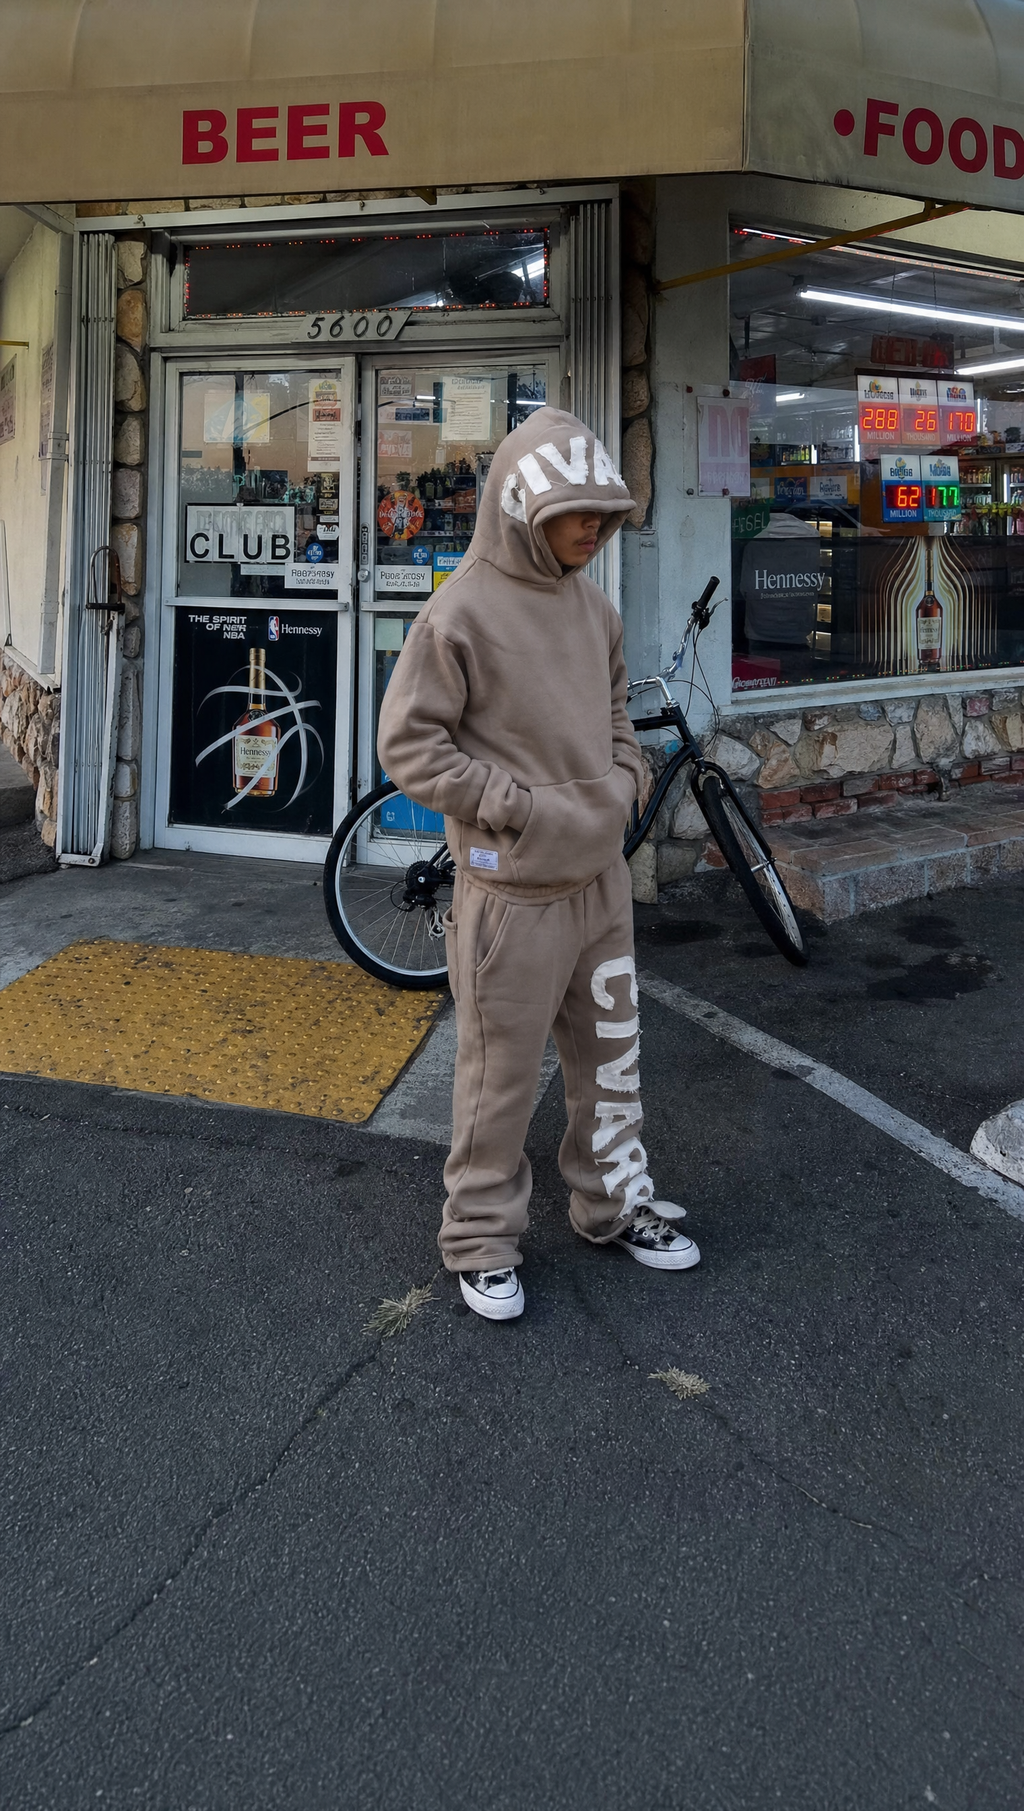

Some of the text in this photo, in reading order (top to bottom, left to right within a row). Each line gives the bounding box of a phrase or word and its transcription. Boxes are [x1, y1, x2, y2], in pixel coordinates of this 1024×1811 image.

[182, 101, 389, 165] BEER
[863, 98, 1024, 180] FOOD
[307, 316, 394, 340] 5600
[863, 408, 898, 430] 288
[915, 410, 936, 431] 26
[949, 412, 974, 432] 170
[867, 431, 895, 440] MILLION
[906, 433, 936, 442] THOUSAND
[946, 434, 972, 442] MILLION
[897, 487, 920, 507] 62
[931, 487, 958, 506] 177
[890, 509, 917, 518] MILLION
[190, 532, 291, 560] CLUB
[755, 569, 826, 592] Hennessy
[188, 614, 247, 624] THE SPIRIT
[206, 623, 221, 631] OF
[223, 631, 245, 640] NBA
[281, 623, 323, 637] Hennessy
